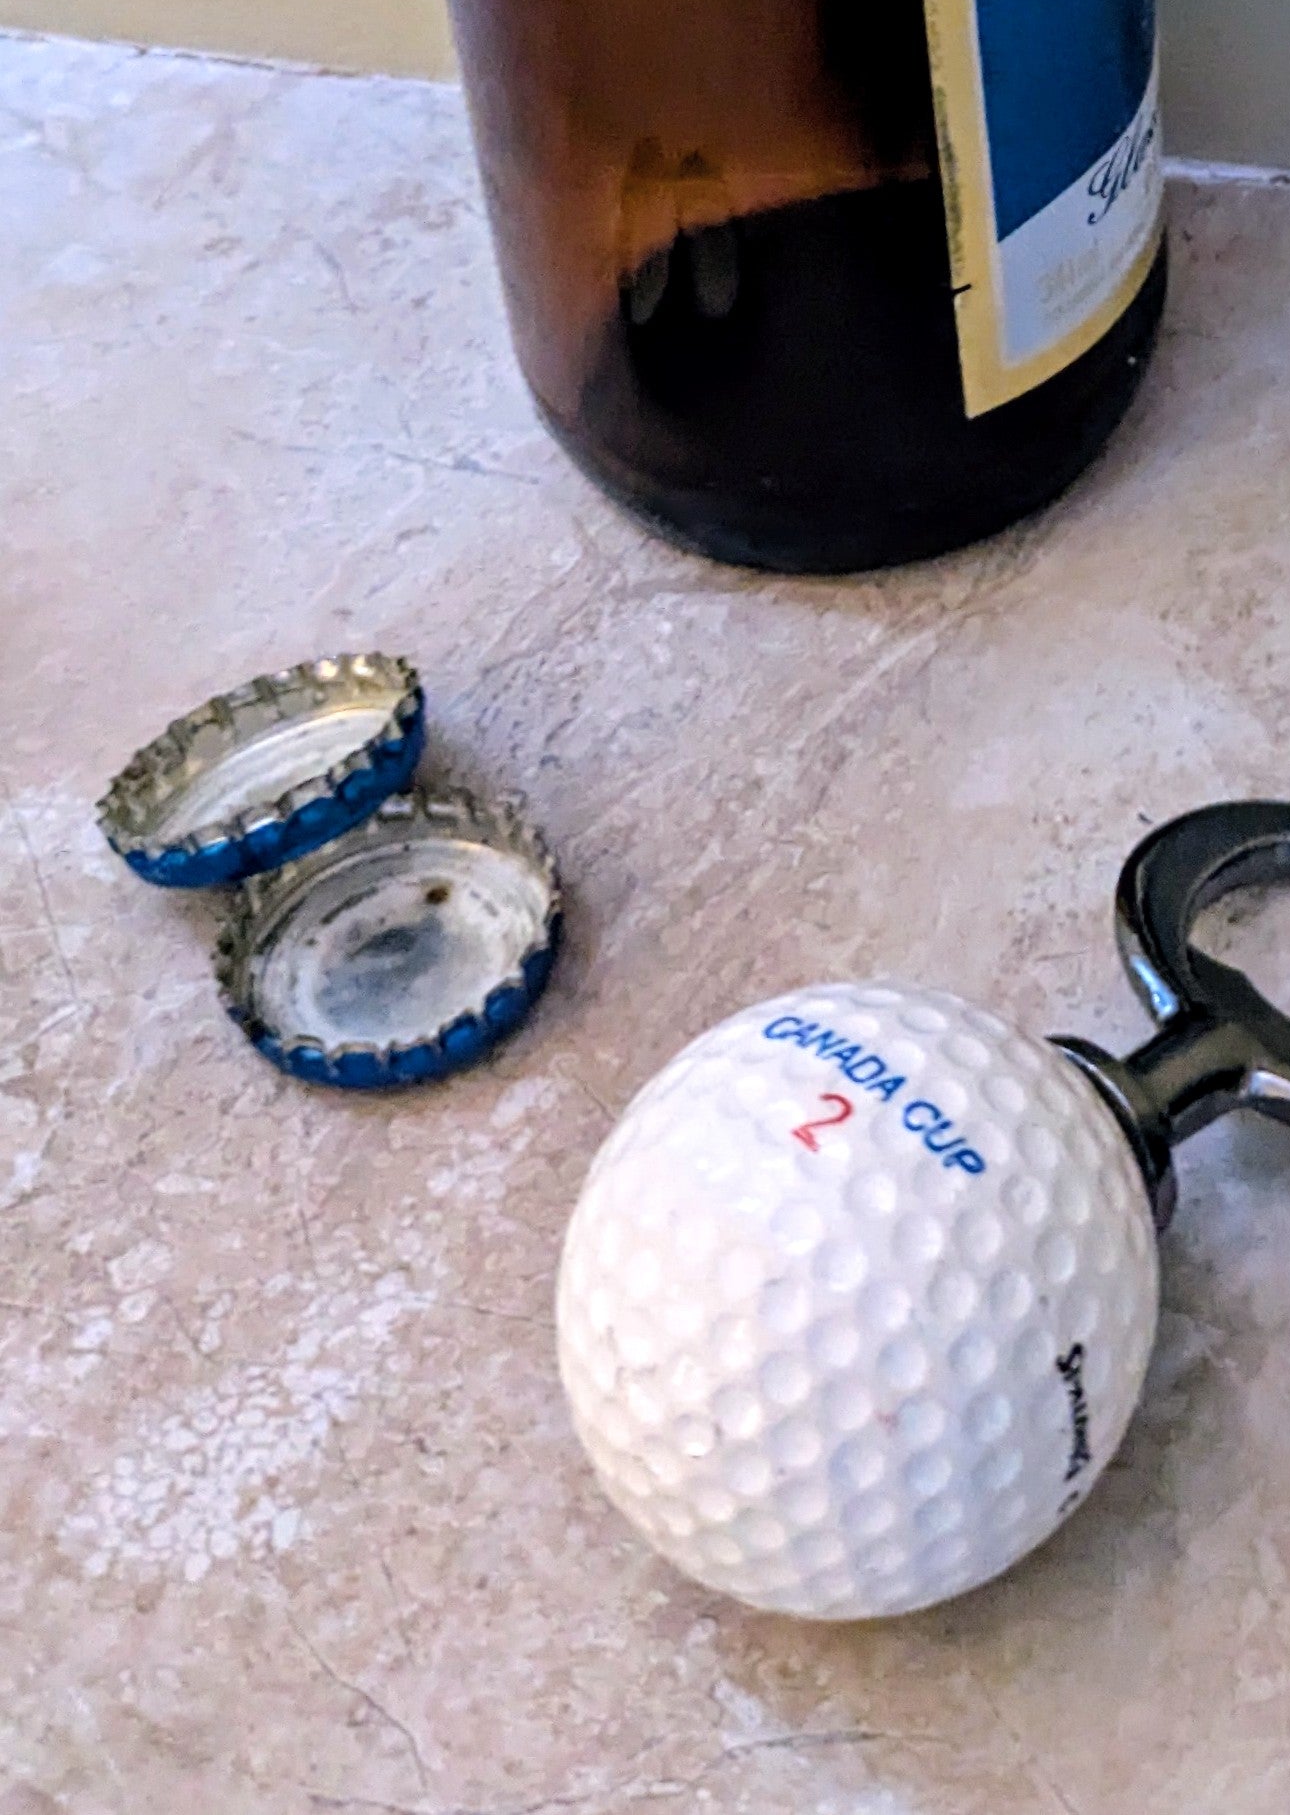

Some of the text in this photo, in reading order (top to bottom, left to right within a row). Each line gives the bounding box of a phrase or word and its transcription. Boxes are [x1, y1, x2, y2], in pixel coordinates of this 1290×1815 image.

[763, 1016, 987, 1175] CANADA CUP
[792, 1093, 854, 1152] 2
